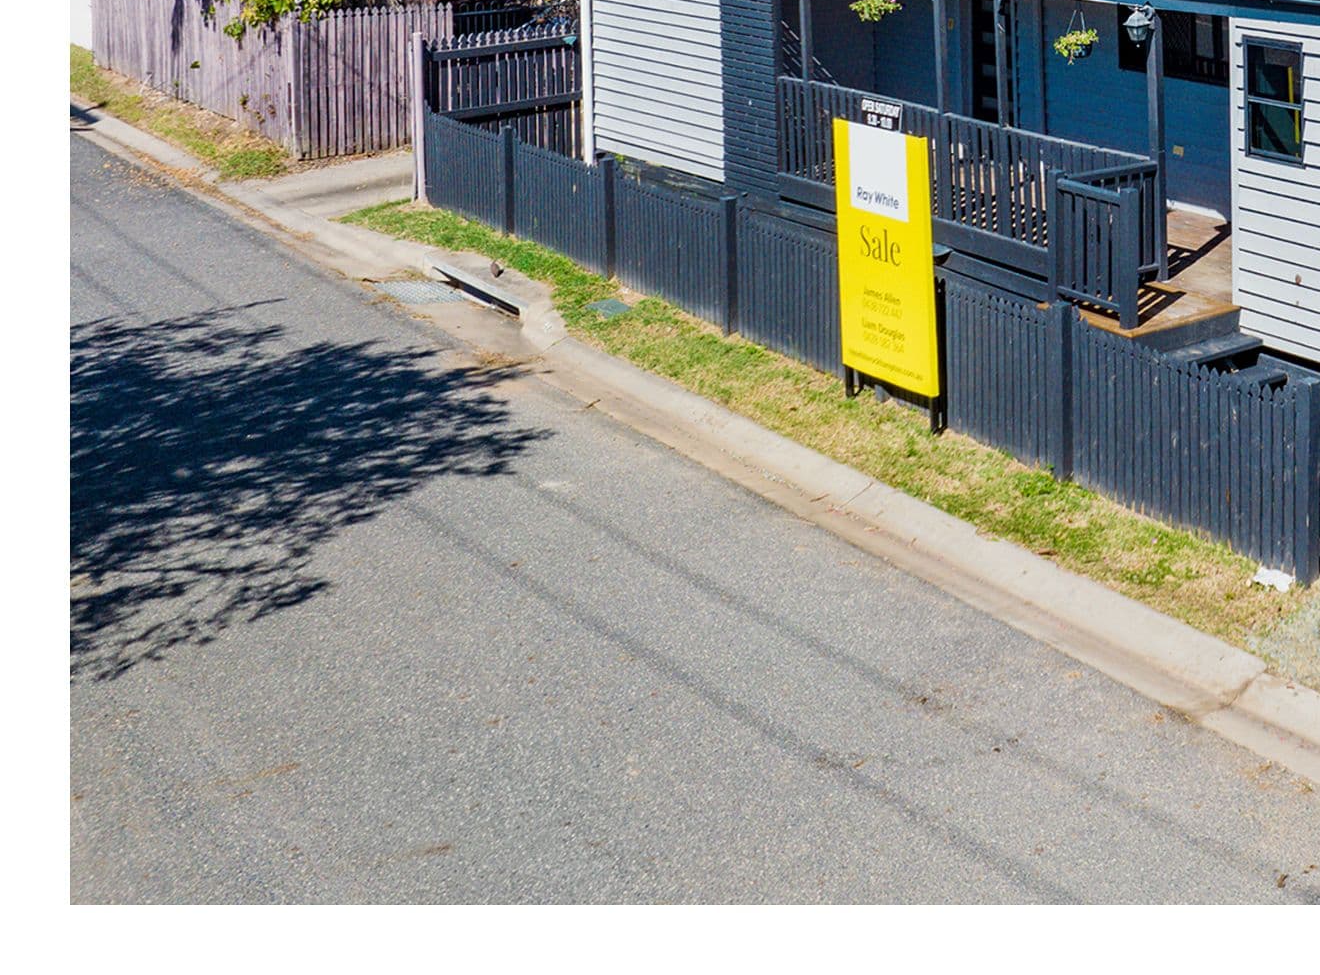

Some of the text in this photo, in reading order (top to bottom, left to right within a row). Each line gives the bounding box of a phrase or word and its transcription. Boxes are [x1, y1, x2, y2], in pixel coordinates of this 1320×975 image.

[856, 186, 900, 210] Ray White
[860, 224, 901, 267] Sale
